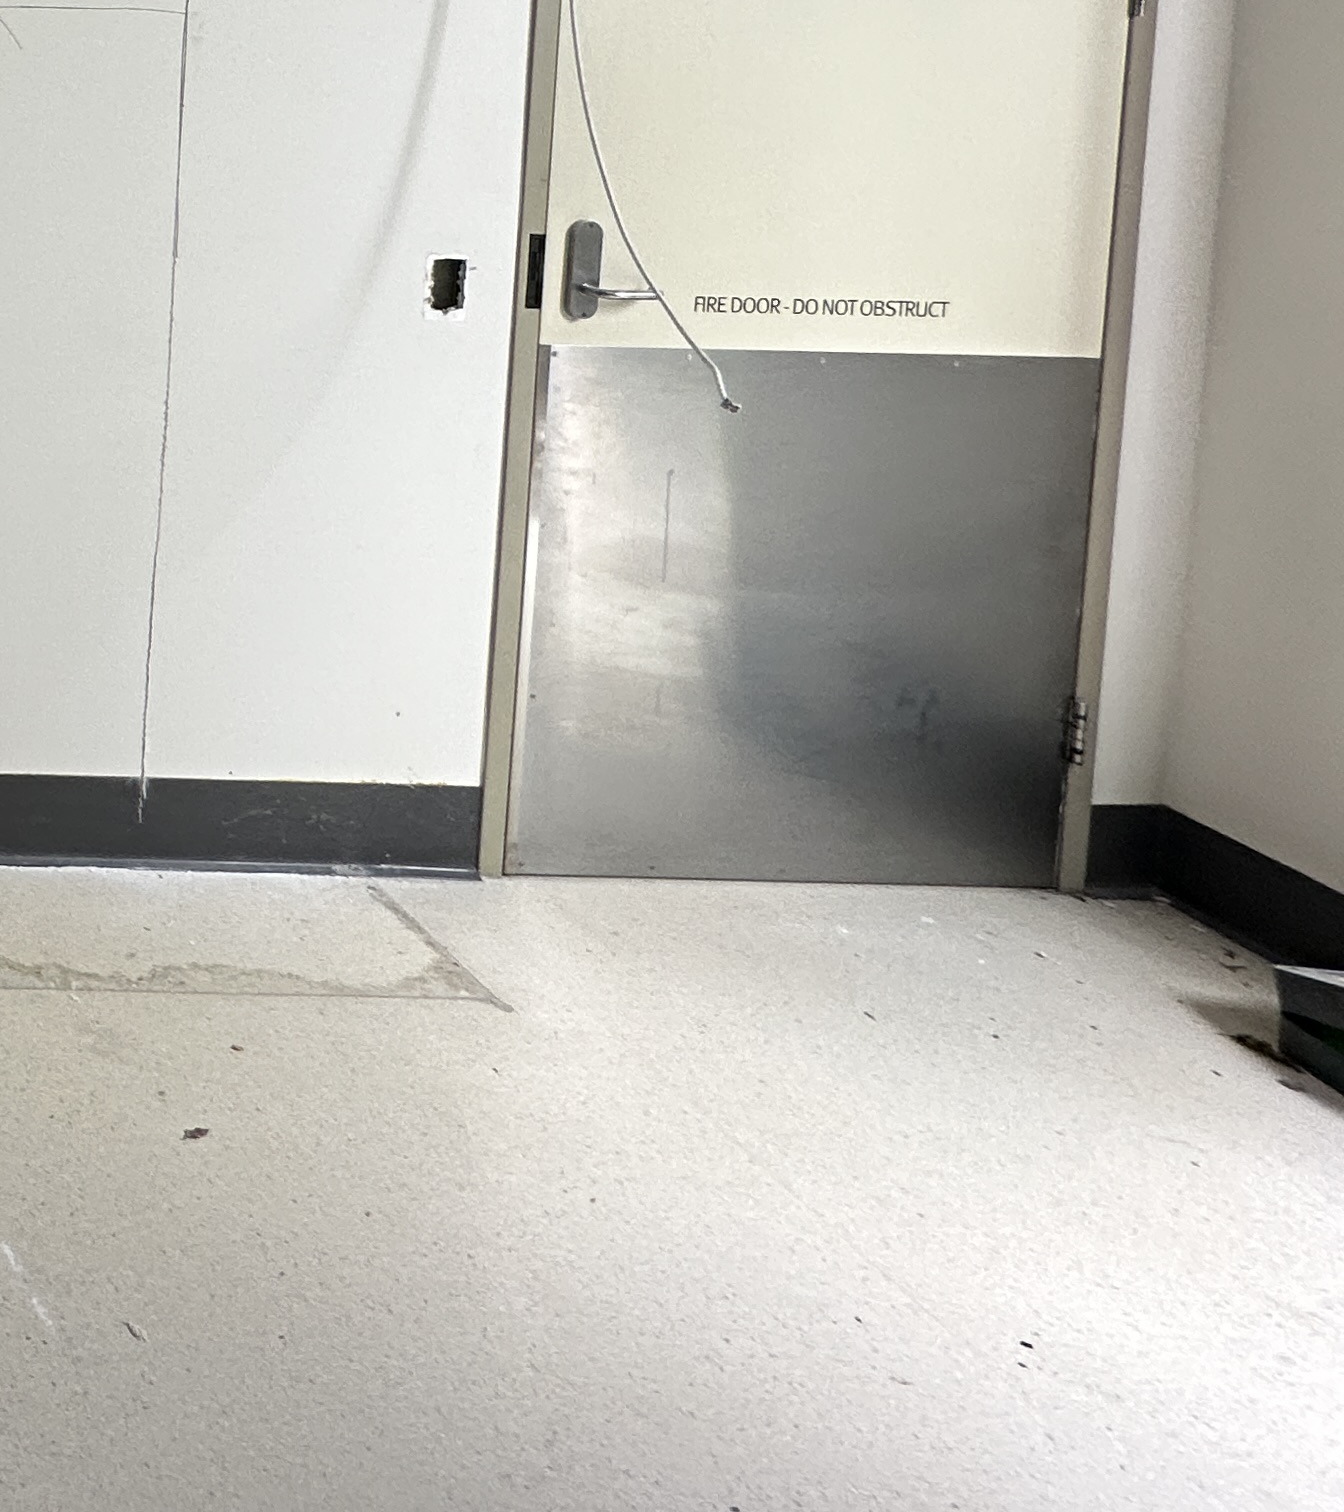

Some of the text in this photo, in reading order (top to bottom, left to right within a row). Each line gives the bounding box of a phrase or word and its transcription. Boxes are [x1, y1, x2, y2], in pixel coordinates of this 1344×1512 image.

[694, 295, 727, 313] FIRE
[730, 296, 781, 314] DOOR
[792, 298, 819, 315] DO
[821, 299, 858, 316] NOT
[861, 300, 950, 318] OBSTRUCT
